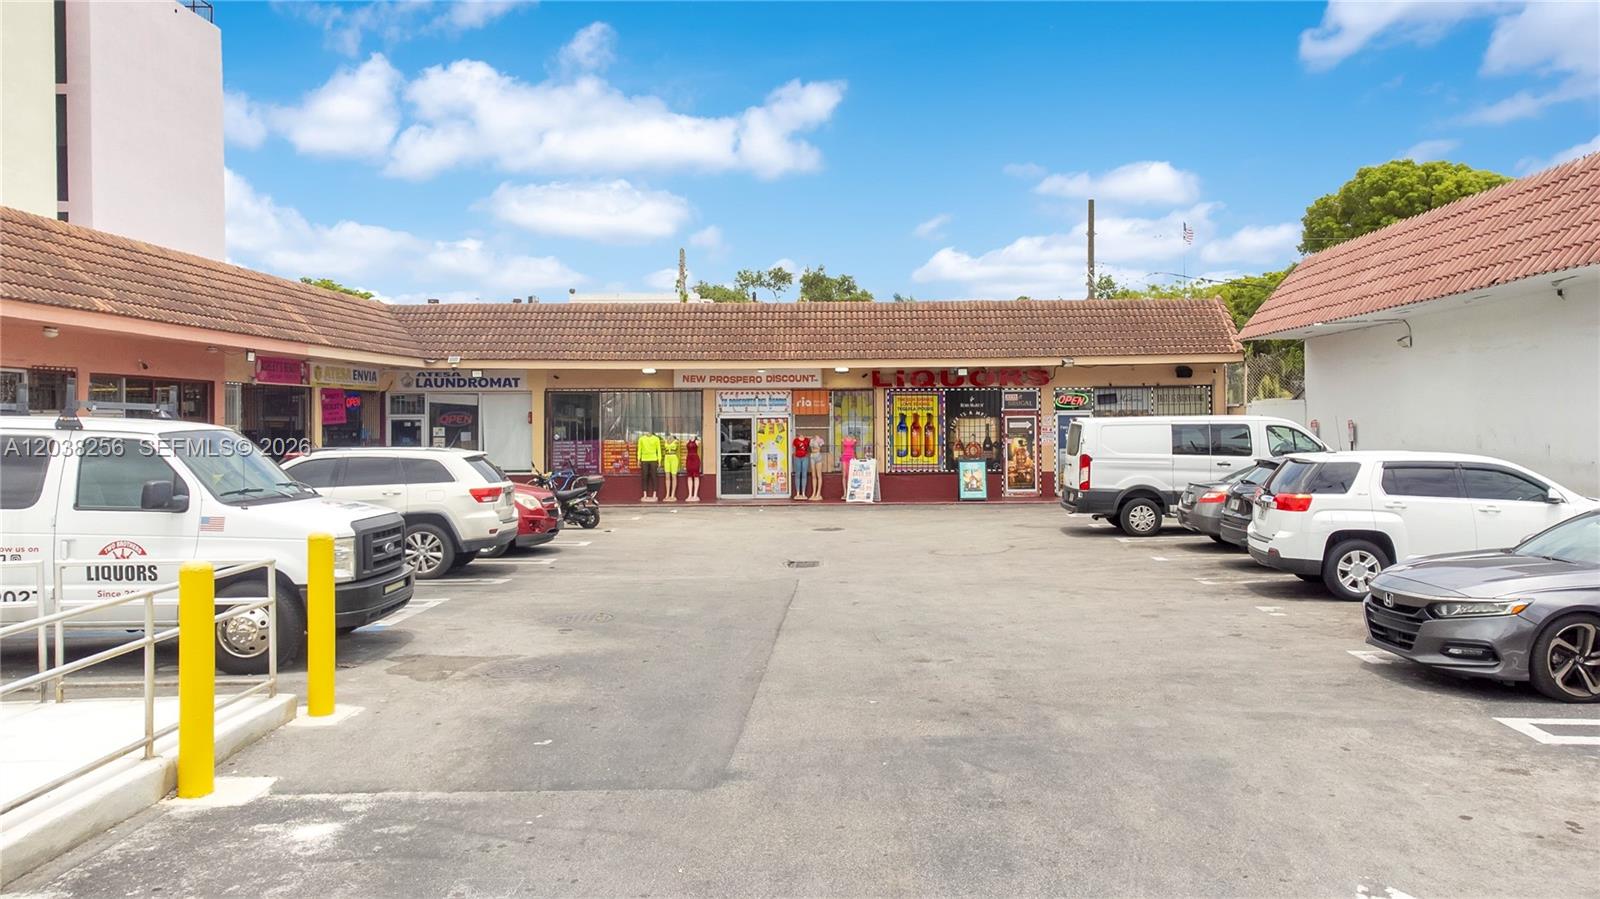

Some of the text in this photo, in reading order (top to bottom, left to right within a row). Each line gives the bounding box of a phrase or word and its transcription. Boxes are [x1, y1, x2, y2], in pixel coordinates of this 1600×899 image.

[352, 369, 377, 382] ENVIA
[682, 375, 706, 383] NEW
[709, 375, 763, 384] PROSPERO
[766, 374, 815, 383] DISCOUNT
[416, 377, 521, 388] LAUNDROMAT
[346, 397, 361, 408] OPEN
[796, 397, 812, 407] ria
[1058, 394, 1085, 405] OPEN
[440, 415, 472, 424] OPEN
[86, 565, 158, 581] LIQUORS
